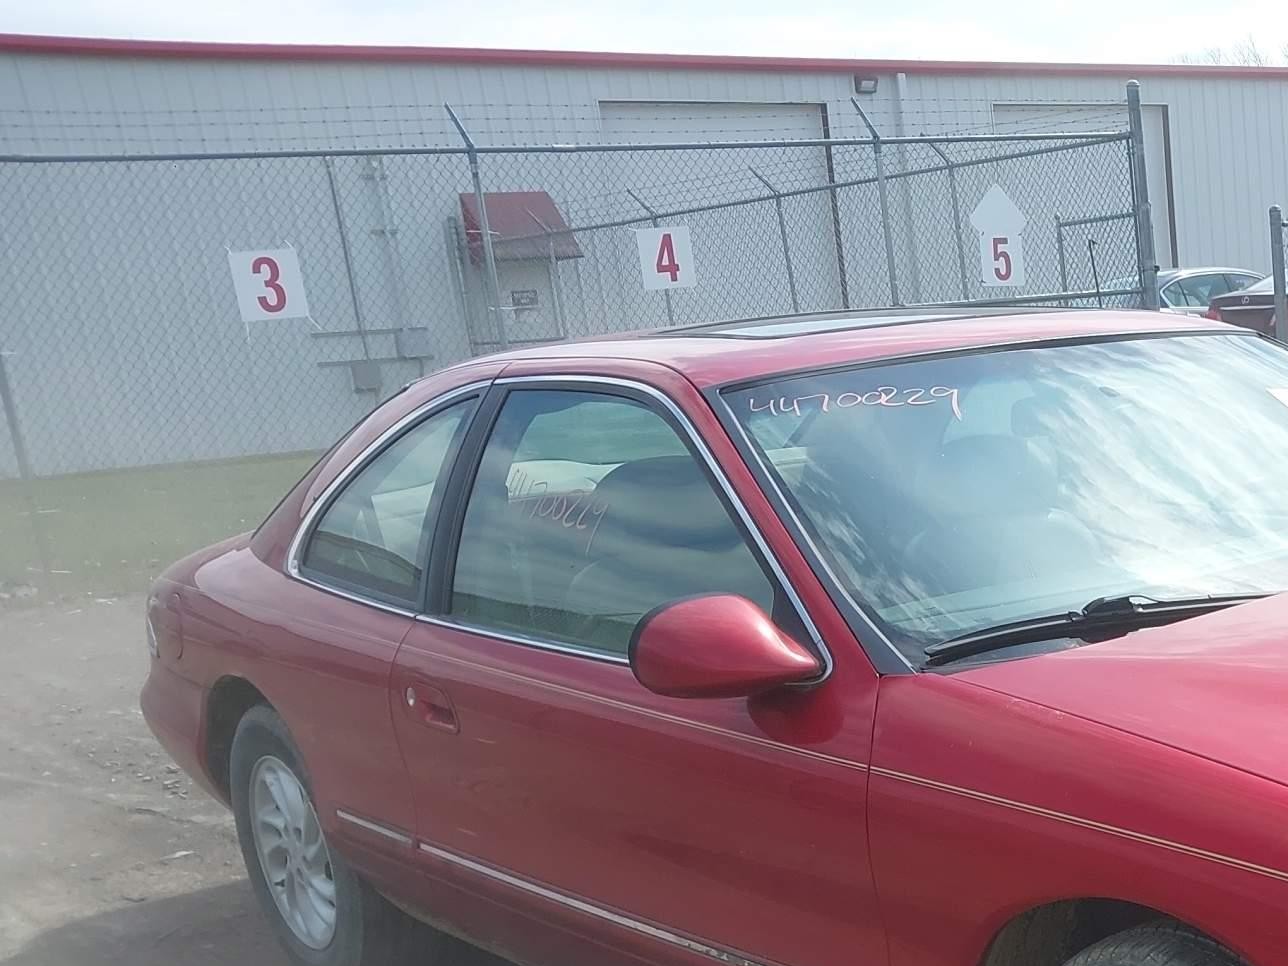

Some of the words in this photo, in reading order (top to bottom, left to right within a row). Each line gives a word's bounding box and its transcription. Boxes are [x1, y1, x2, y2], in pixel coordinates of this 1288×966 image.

[656, 233, 680, 282] 4
[992, 237, 1012, 281] 5
[252, 256, 287, 313] 3
[749, 386, 962, 421] 44700229
